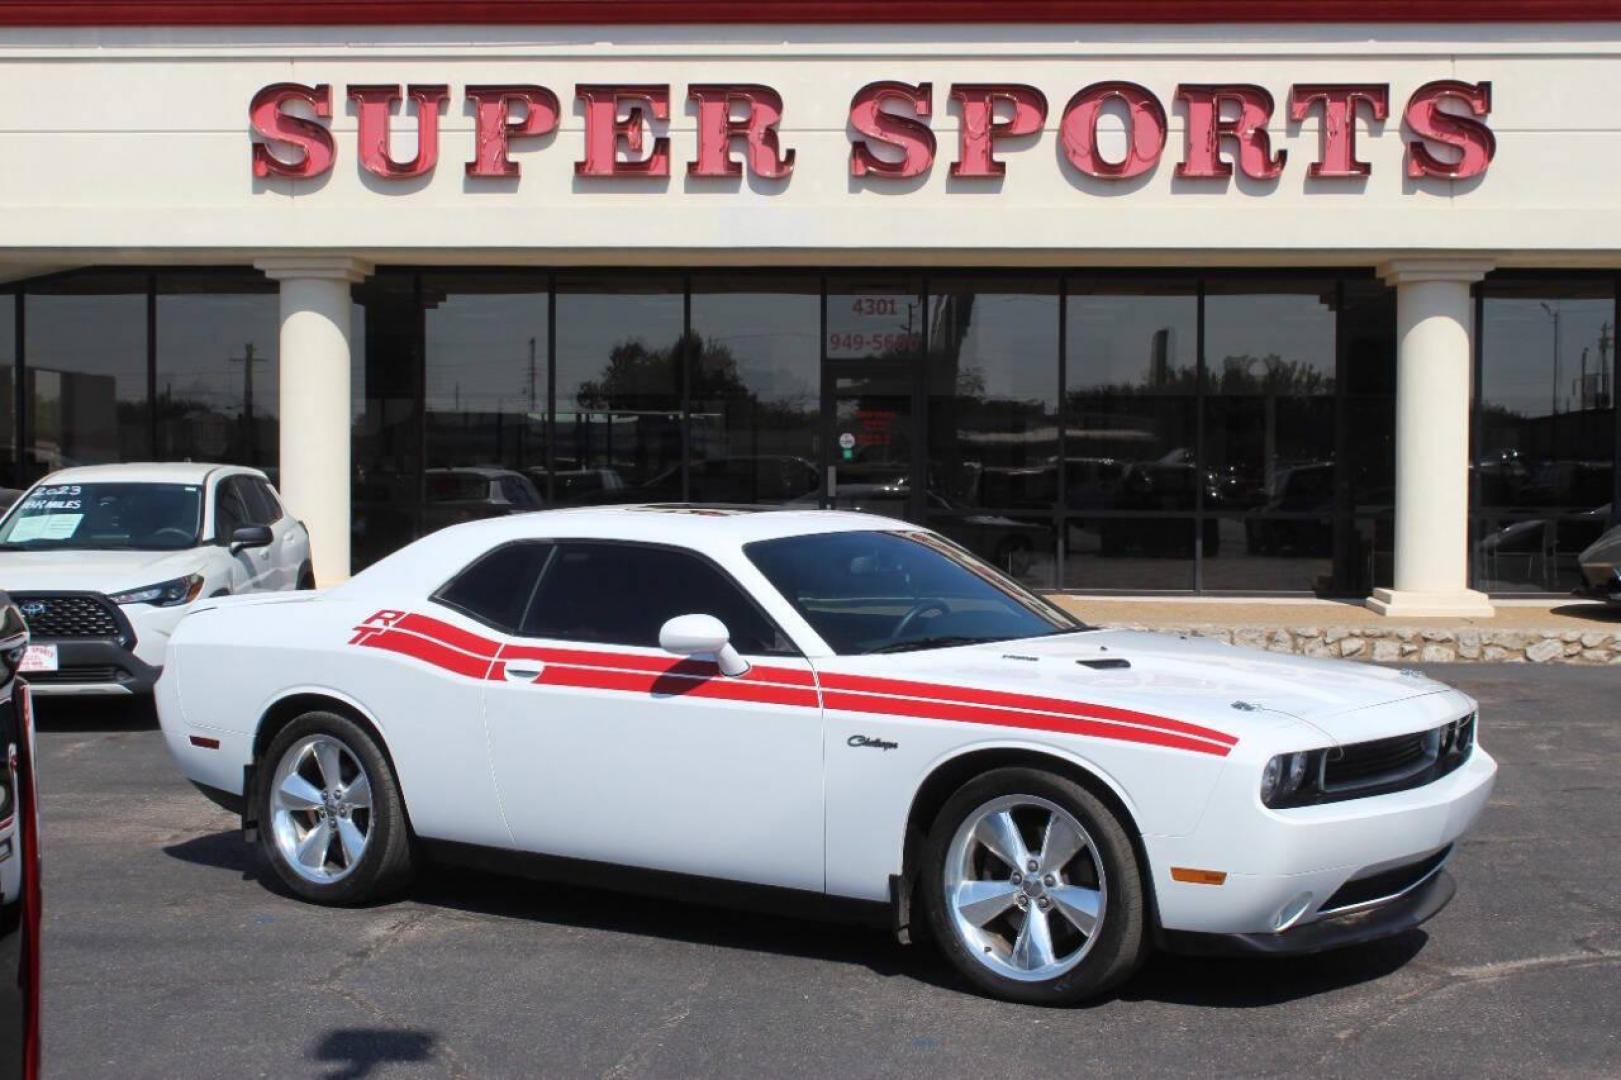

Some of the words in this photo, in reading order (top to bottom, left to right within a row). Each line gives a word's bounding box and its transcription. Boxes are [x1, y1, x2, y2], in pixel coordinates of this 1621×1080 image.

[249, 82, 796, 180] SUPER
[849, 80, 1496, 181] SPORTS
[852, 298, 898, 316] 4301
[31, 485, 82, 496] 2023
[45, 500, 82, 510] MILES
